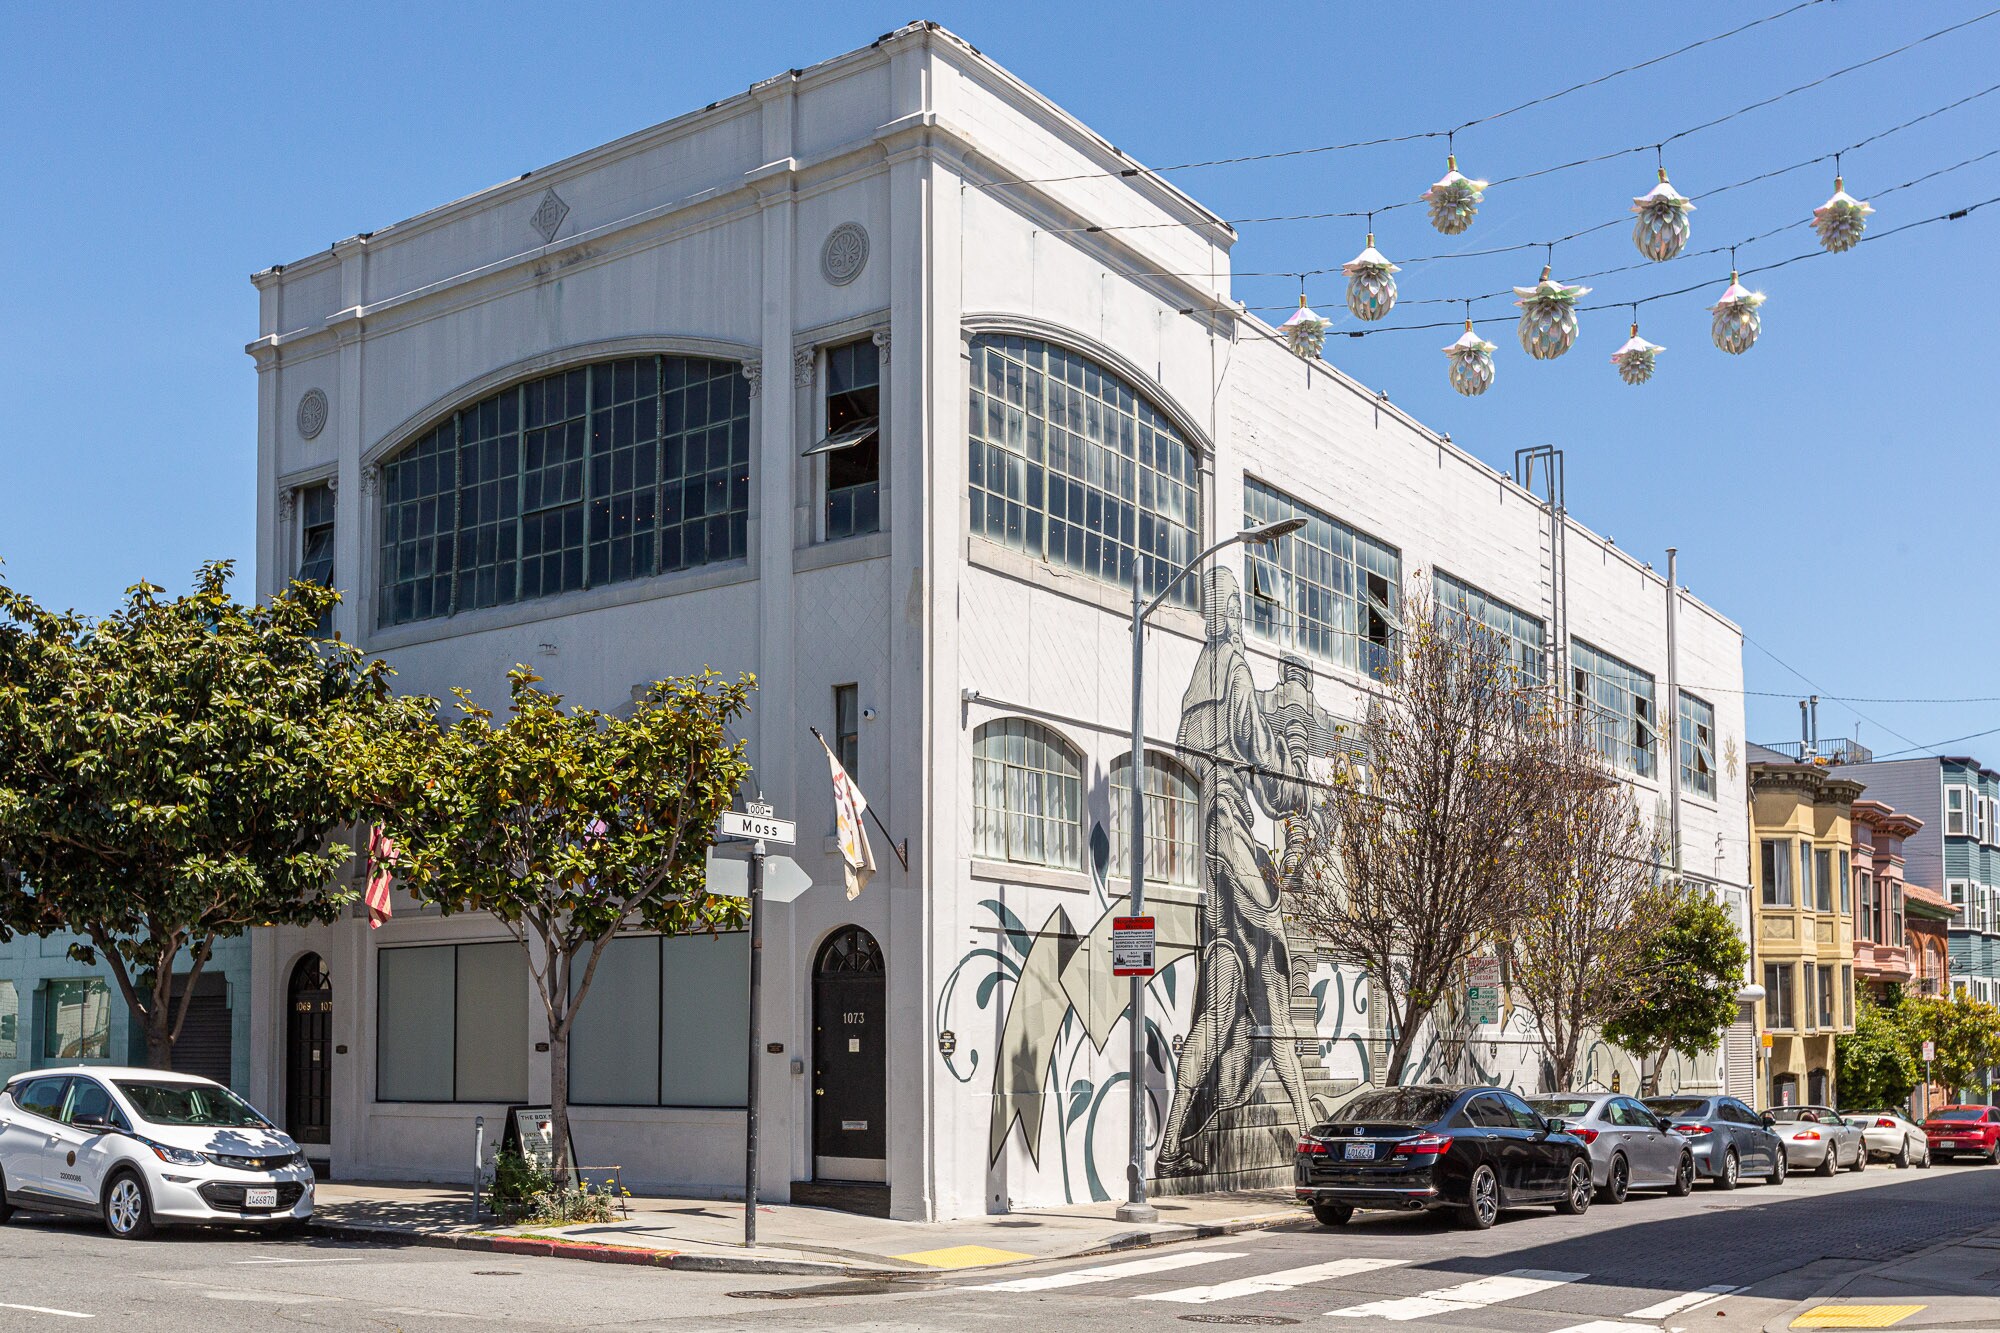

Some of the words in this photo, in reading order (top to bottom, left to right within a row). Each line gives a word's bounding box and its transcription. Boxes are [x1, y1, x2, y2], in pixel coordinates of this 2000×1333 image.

[742, 819, 778, 836] Moss
[1471, 989, 1478, 998] 2
[296, 1002, 311, 1011] 1069
[320, 1002, 333, 1011] 107
[843, 1012, 865, 1023] 1073
[248, 1196, 275, 1204] 1466870
